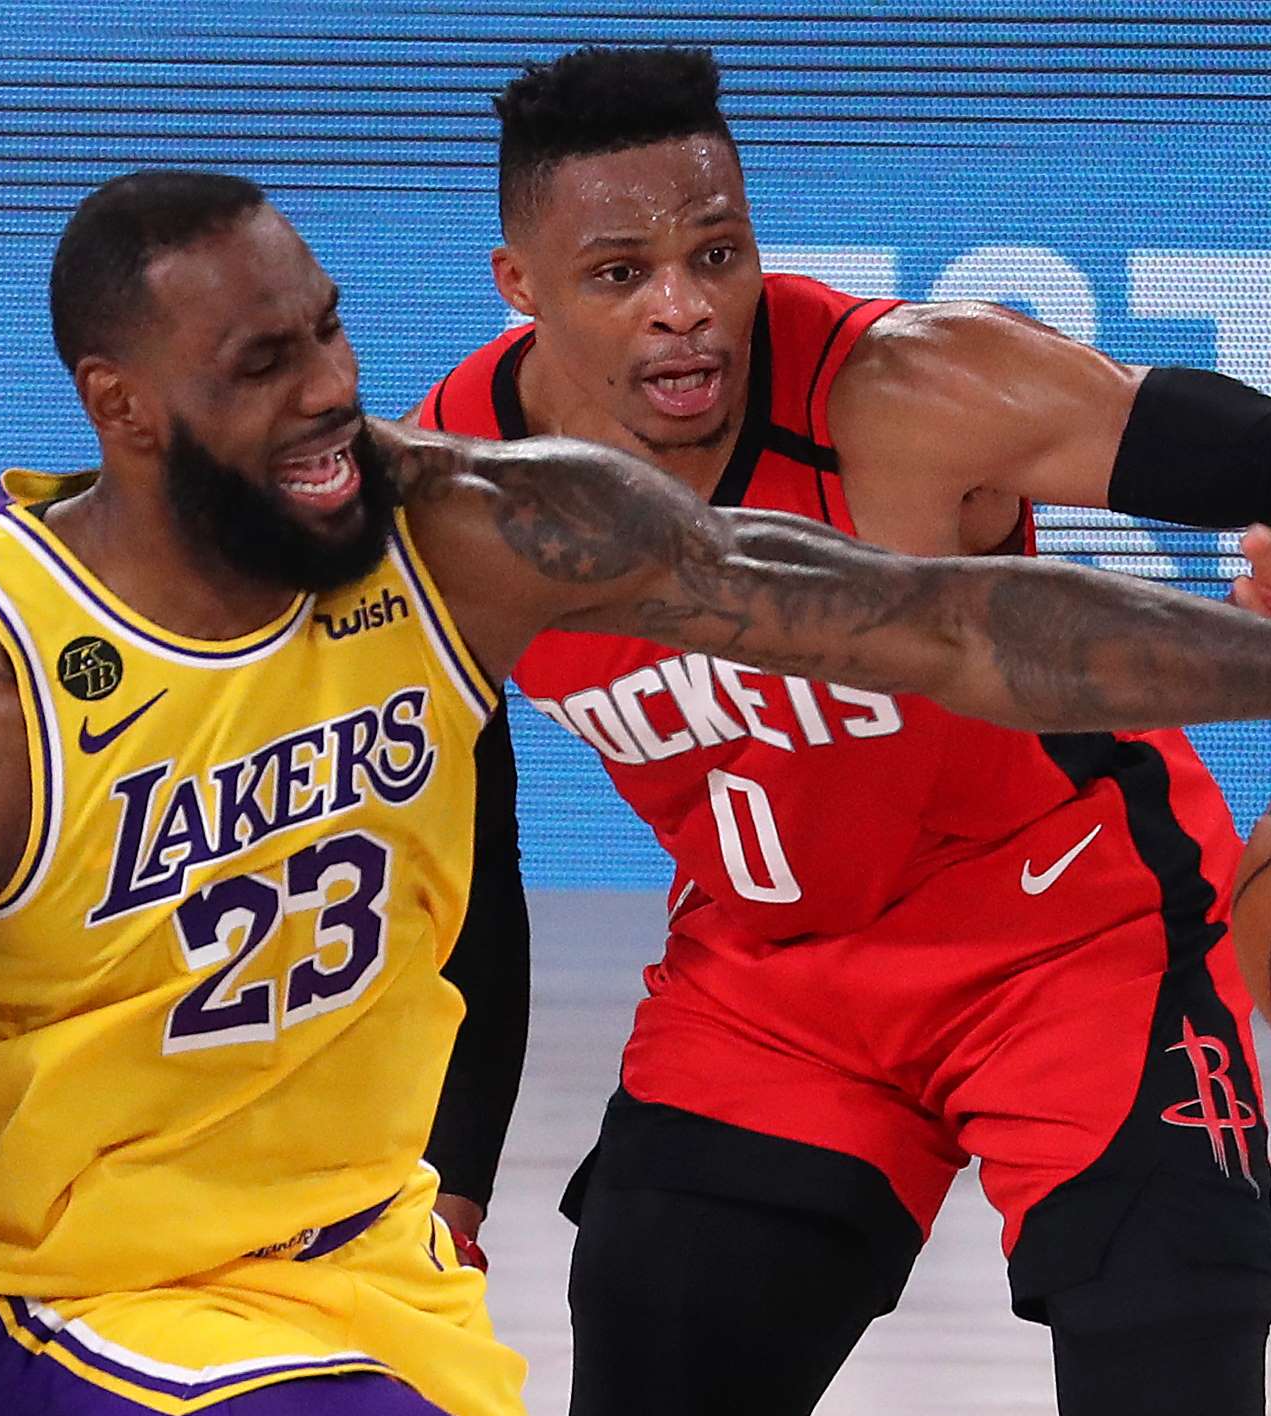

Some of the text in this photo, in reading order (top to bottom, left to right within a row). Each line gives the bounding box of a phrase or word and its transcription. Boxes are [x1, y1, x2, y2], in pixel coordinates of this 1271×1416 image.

[313, 588, 409, 640] wish
[85, 687, 435, 928] LAKERS
[706, 767, 803, 904] 0
[161, 830, 393, 1057] 23
